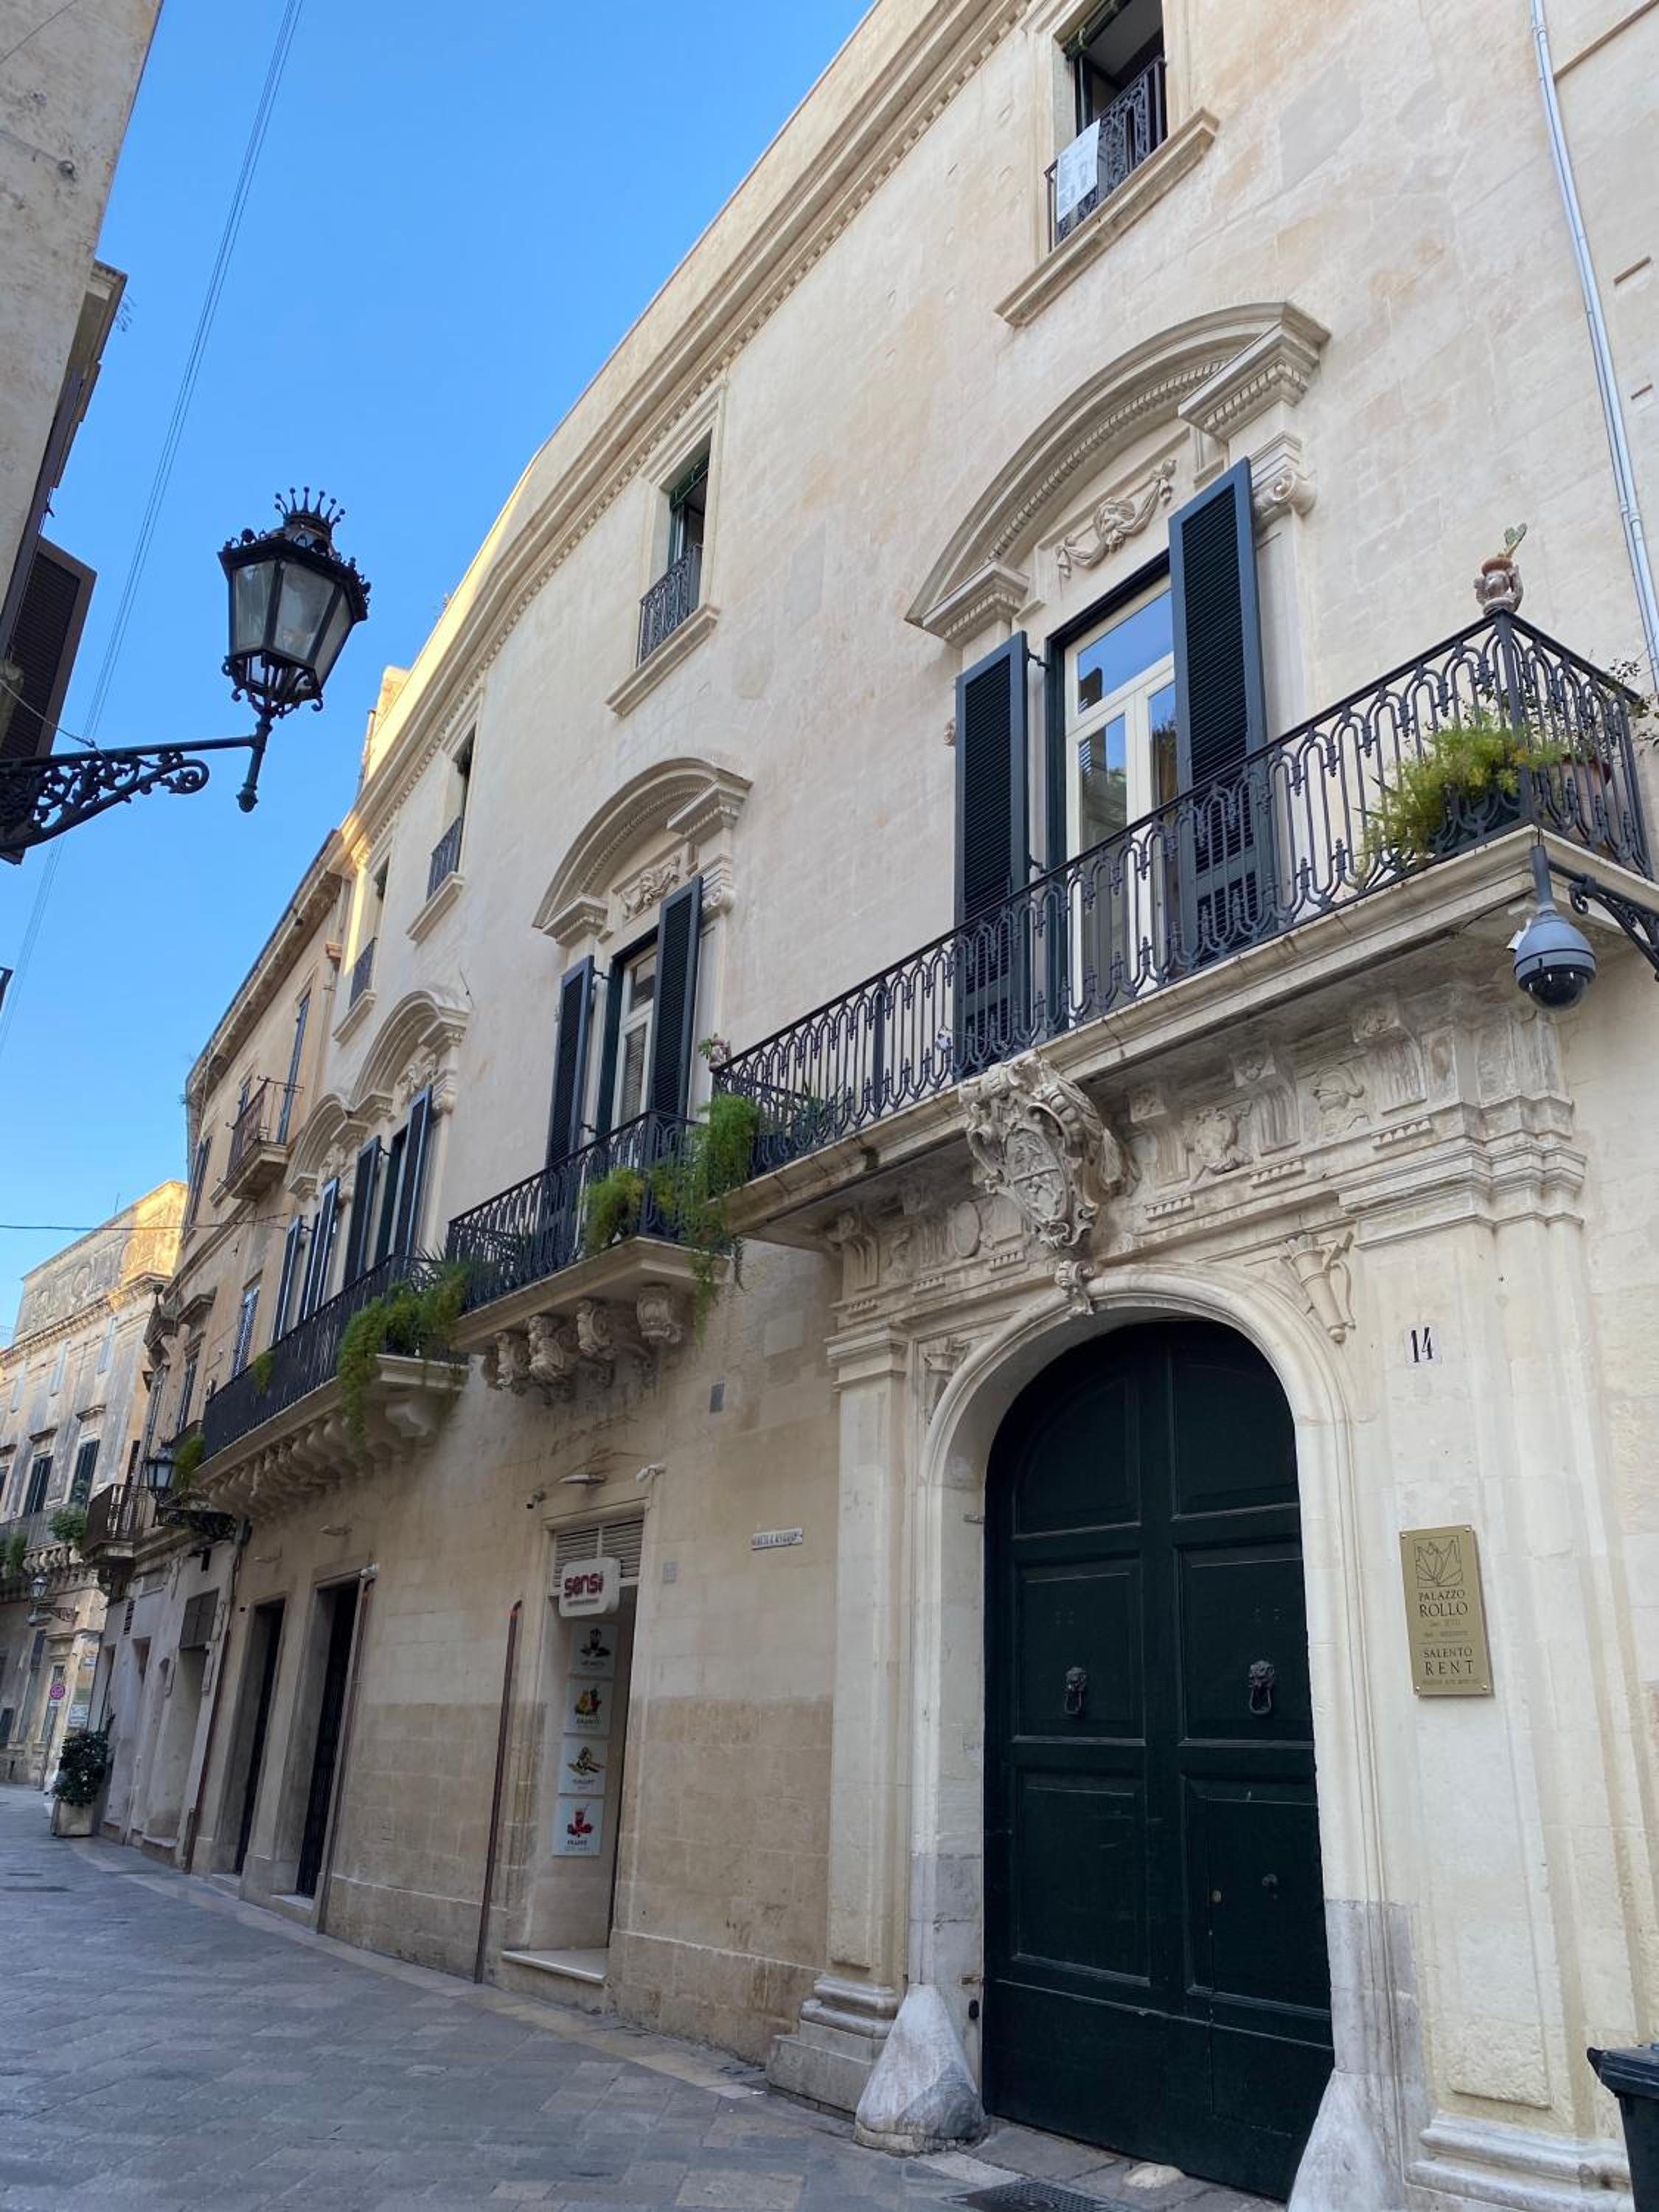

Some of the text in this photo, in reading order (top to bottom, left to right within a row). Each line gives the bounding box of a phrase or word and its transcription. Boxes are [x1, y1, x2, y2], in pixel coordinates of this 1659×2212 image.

[1411, 1326, 1433, 1363] 14
[1419, 1589, 1465, 1601] PALAZZO
[1419, 1601, 1468, 1617] ROLLO
[1424, 1646, 1472, 1658] SALENTO
[1425, 1660, 1473, 1675] RENT
